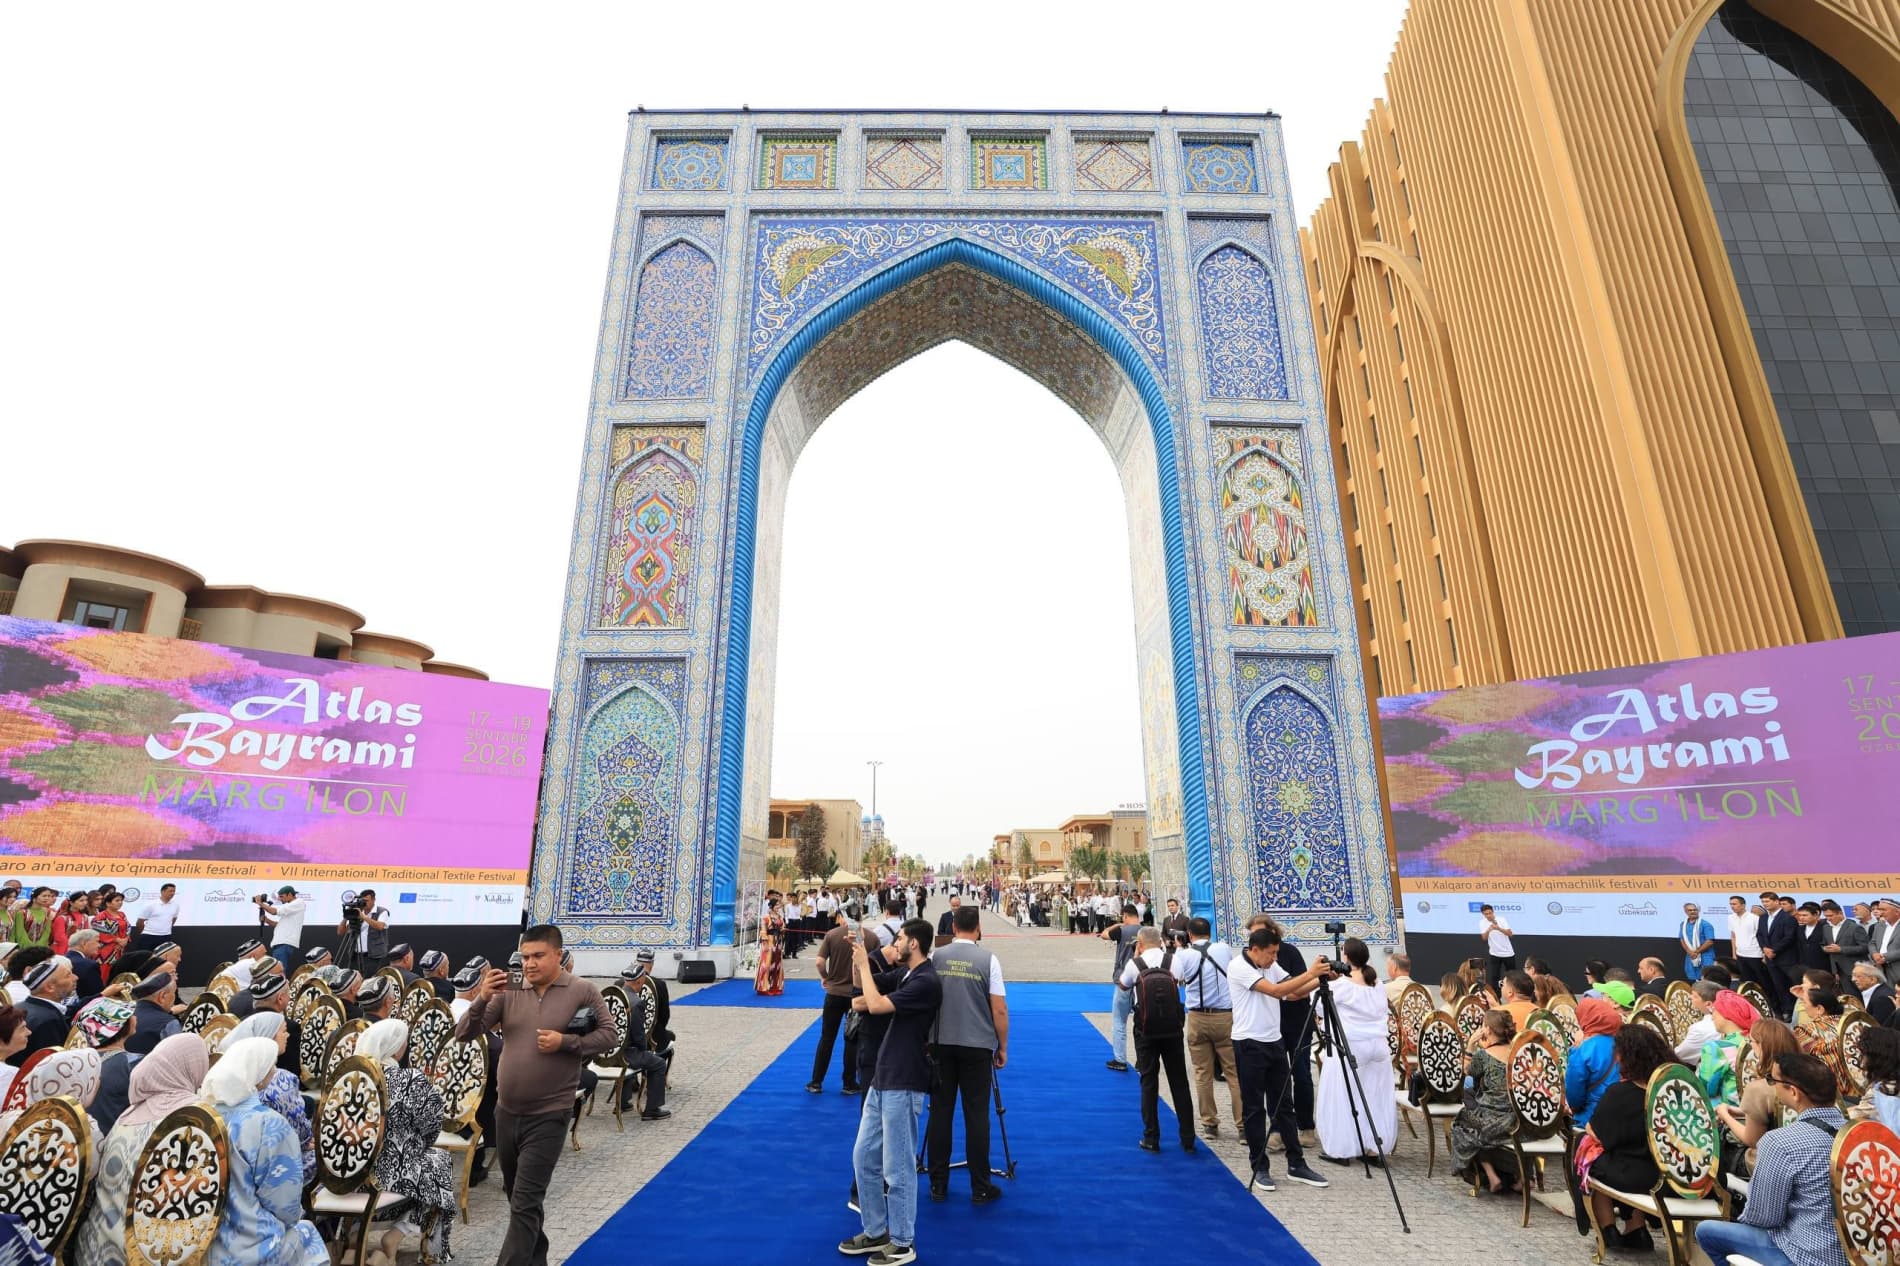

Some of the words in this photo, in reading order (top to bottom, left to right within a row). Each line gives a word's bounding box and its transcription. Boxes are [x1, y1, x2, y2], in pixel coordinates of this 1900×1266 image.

[229, 678, 423, 727] Atlas
[1842, 674, 1873, 695] 17
[1570, 682, 1779, 742] Atlas
[145, 712, 416, 771] Bayrami
[463, 741, 527, 768] 2026
[1514, 721, 1790, 789] Bayrami
[139, 774, 408, 817] MARG'ILON
[1525, 786, 1803, 827] MARG'ILON
[206, 864, 257, 876] festivali
[281, 866, 298, 877] VII
[302, 866, 378, 878] International
[382, 869, 440, 880] Traditional
[443, 870, 477, 881] Textile
[478, 871, 516, 881] Festival
[1415, 881, 1429, 889] VII
[1432, 881, 1472, 892] Xalqaro
[1609, 878, 1658, 889] festivali
[1682, 878, 1702, 889] VII
[1707, 877, 1801, 889] International
[1804, 877, 1892, 889] Traditional
[1493, 903, 1522, 911] nesco
